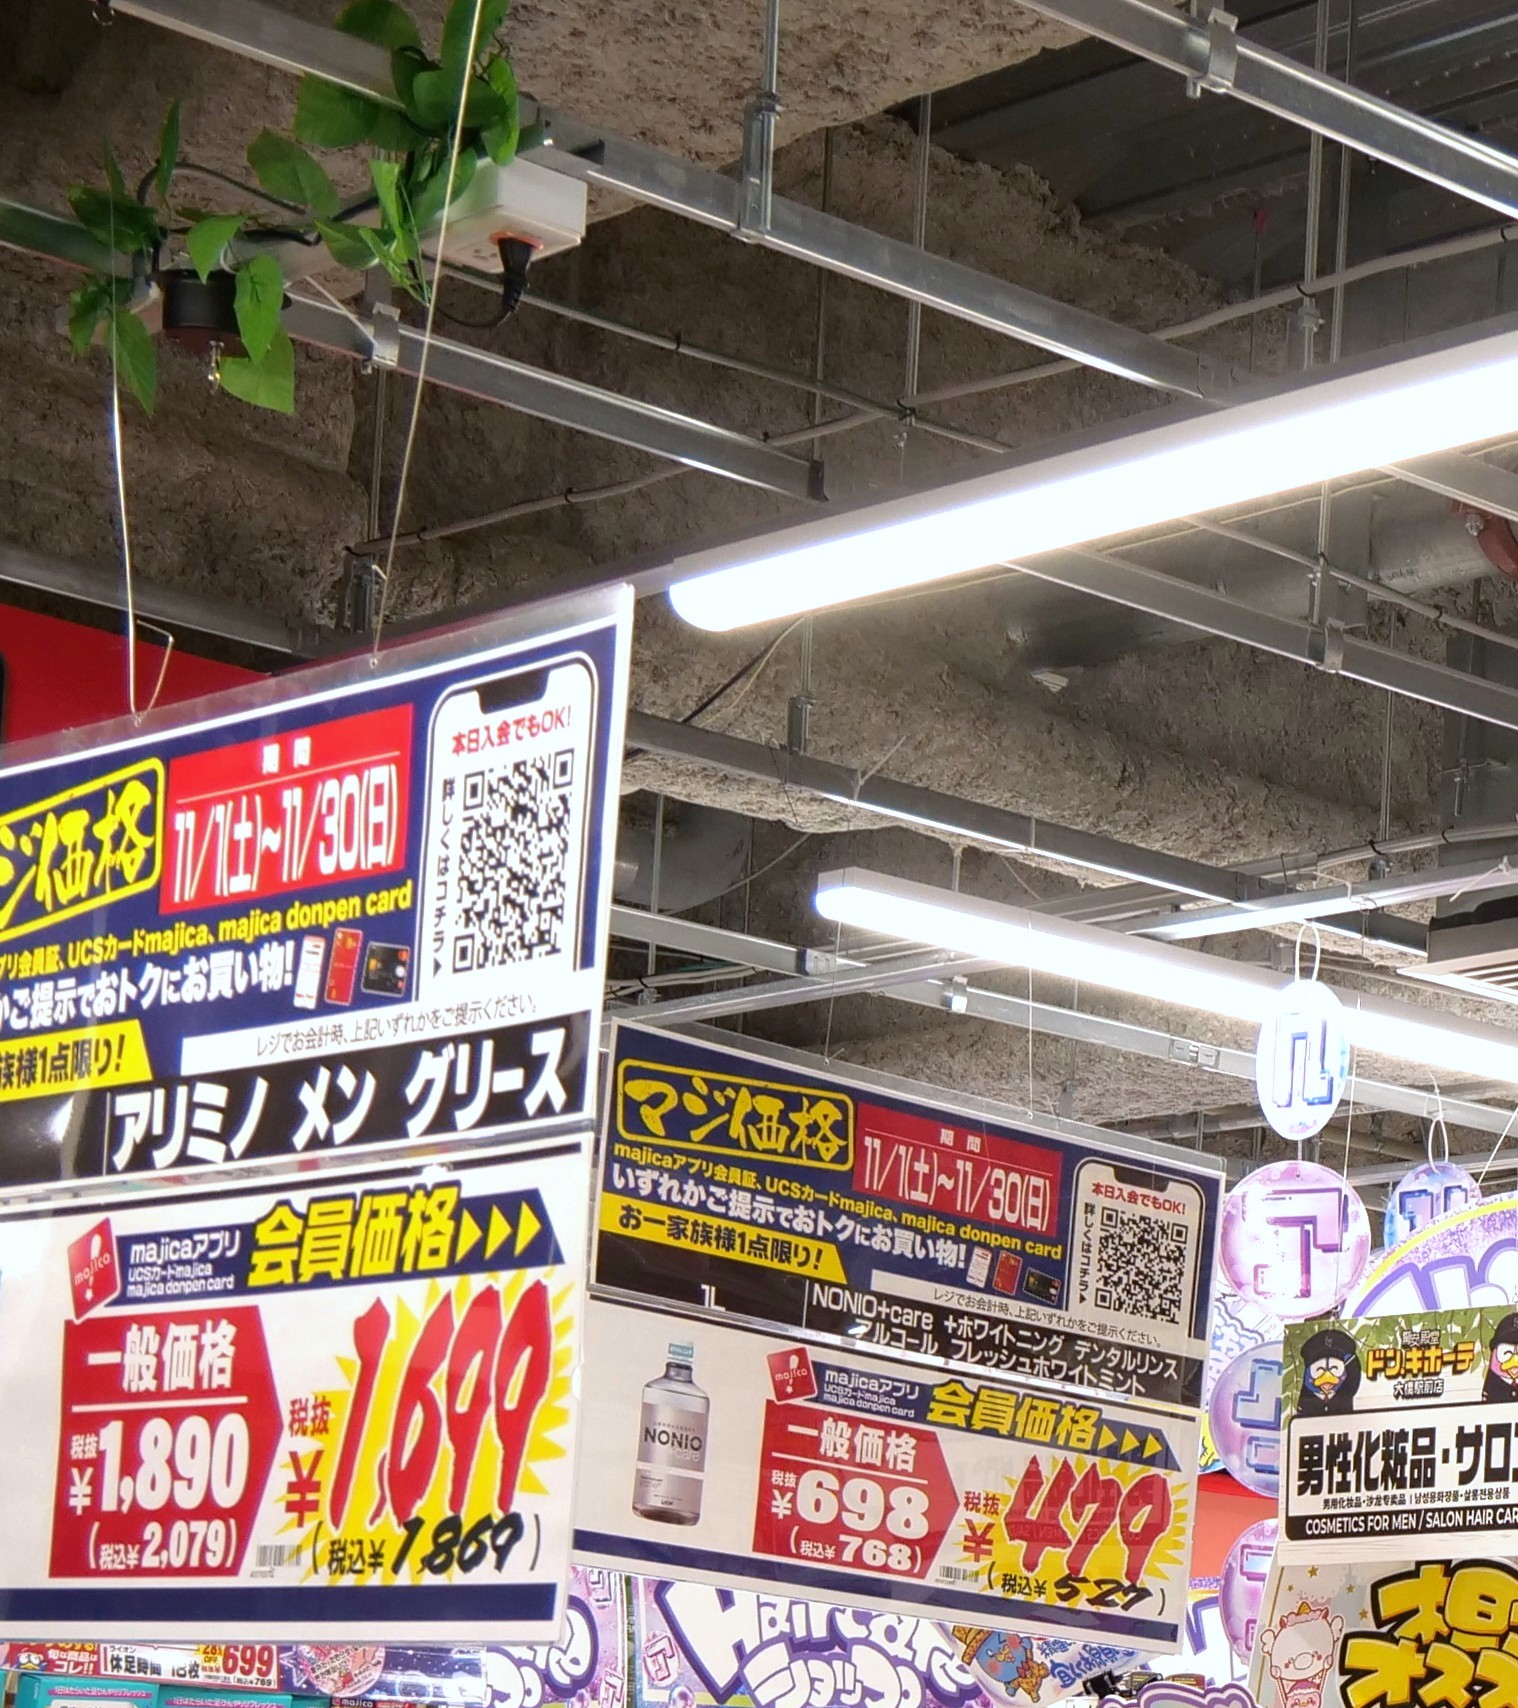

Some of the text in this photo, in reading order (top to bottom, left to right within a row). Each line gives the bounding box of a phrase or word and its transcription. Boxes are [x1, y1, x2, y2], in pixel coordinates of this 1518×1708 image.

[113, 1030, 568, 1172] アリミノ メン グリース
[624, 1076, 847, 1161] マジ価格
[247, 1183, 461, 1287] 会員価格
[87, 1322, 236, 1392] 一般価格
[787, 1416, 918, 1473] 一般価格
[927, 1380, 1100, 1450] 会員価格
[1306, 1516, 1365, 1535] COSMETICS
[1368, 1515, 1390, 1531] FOR
[1392, 1513, 1417, 1529] MEN
[1425, 1511, 1462, 1527] SALON
[1465, 1509, 1493, 1525] HAIR
